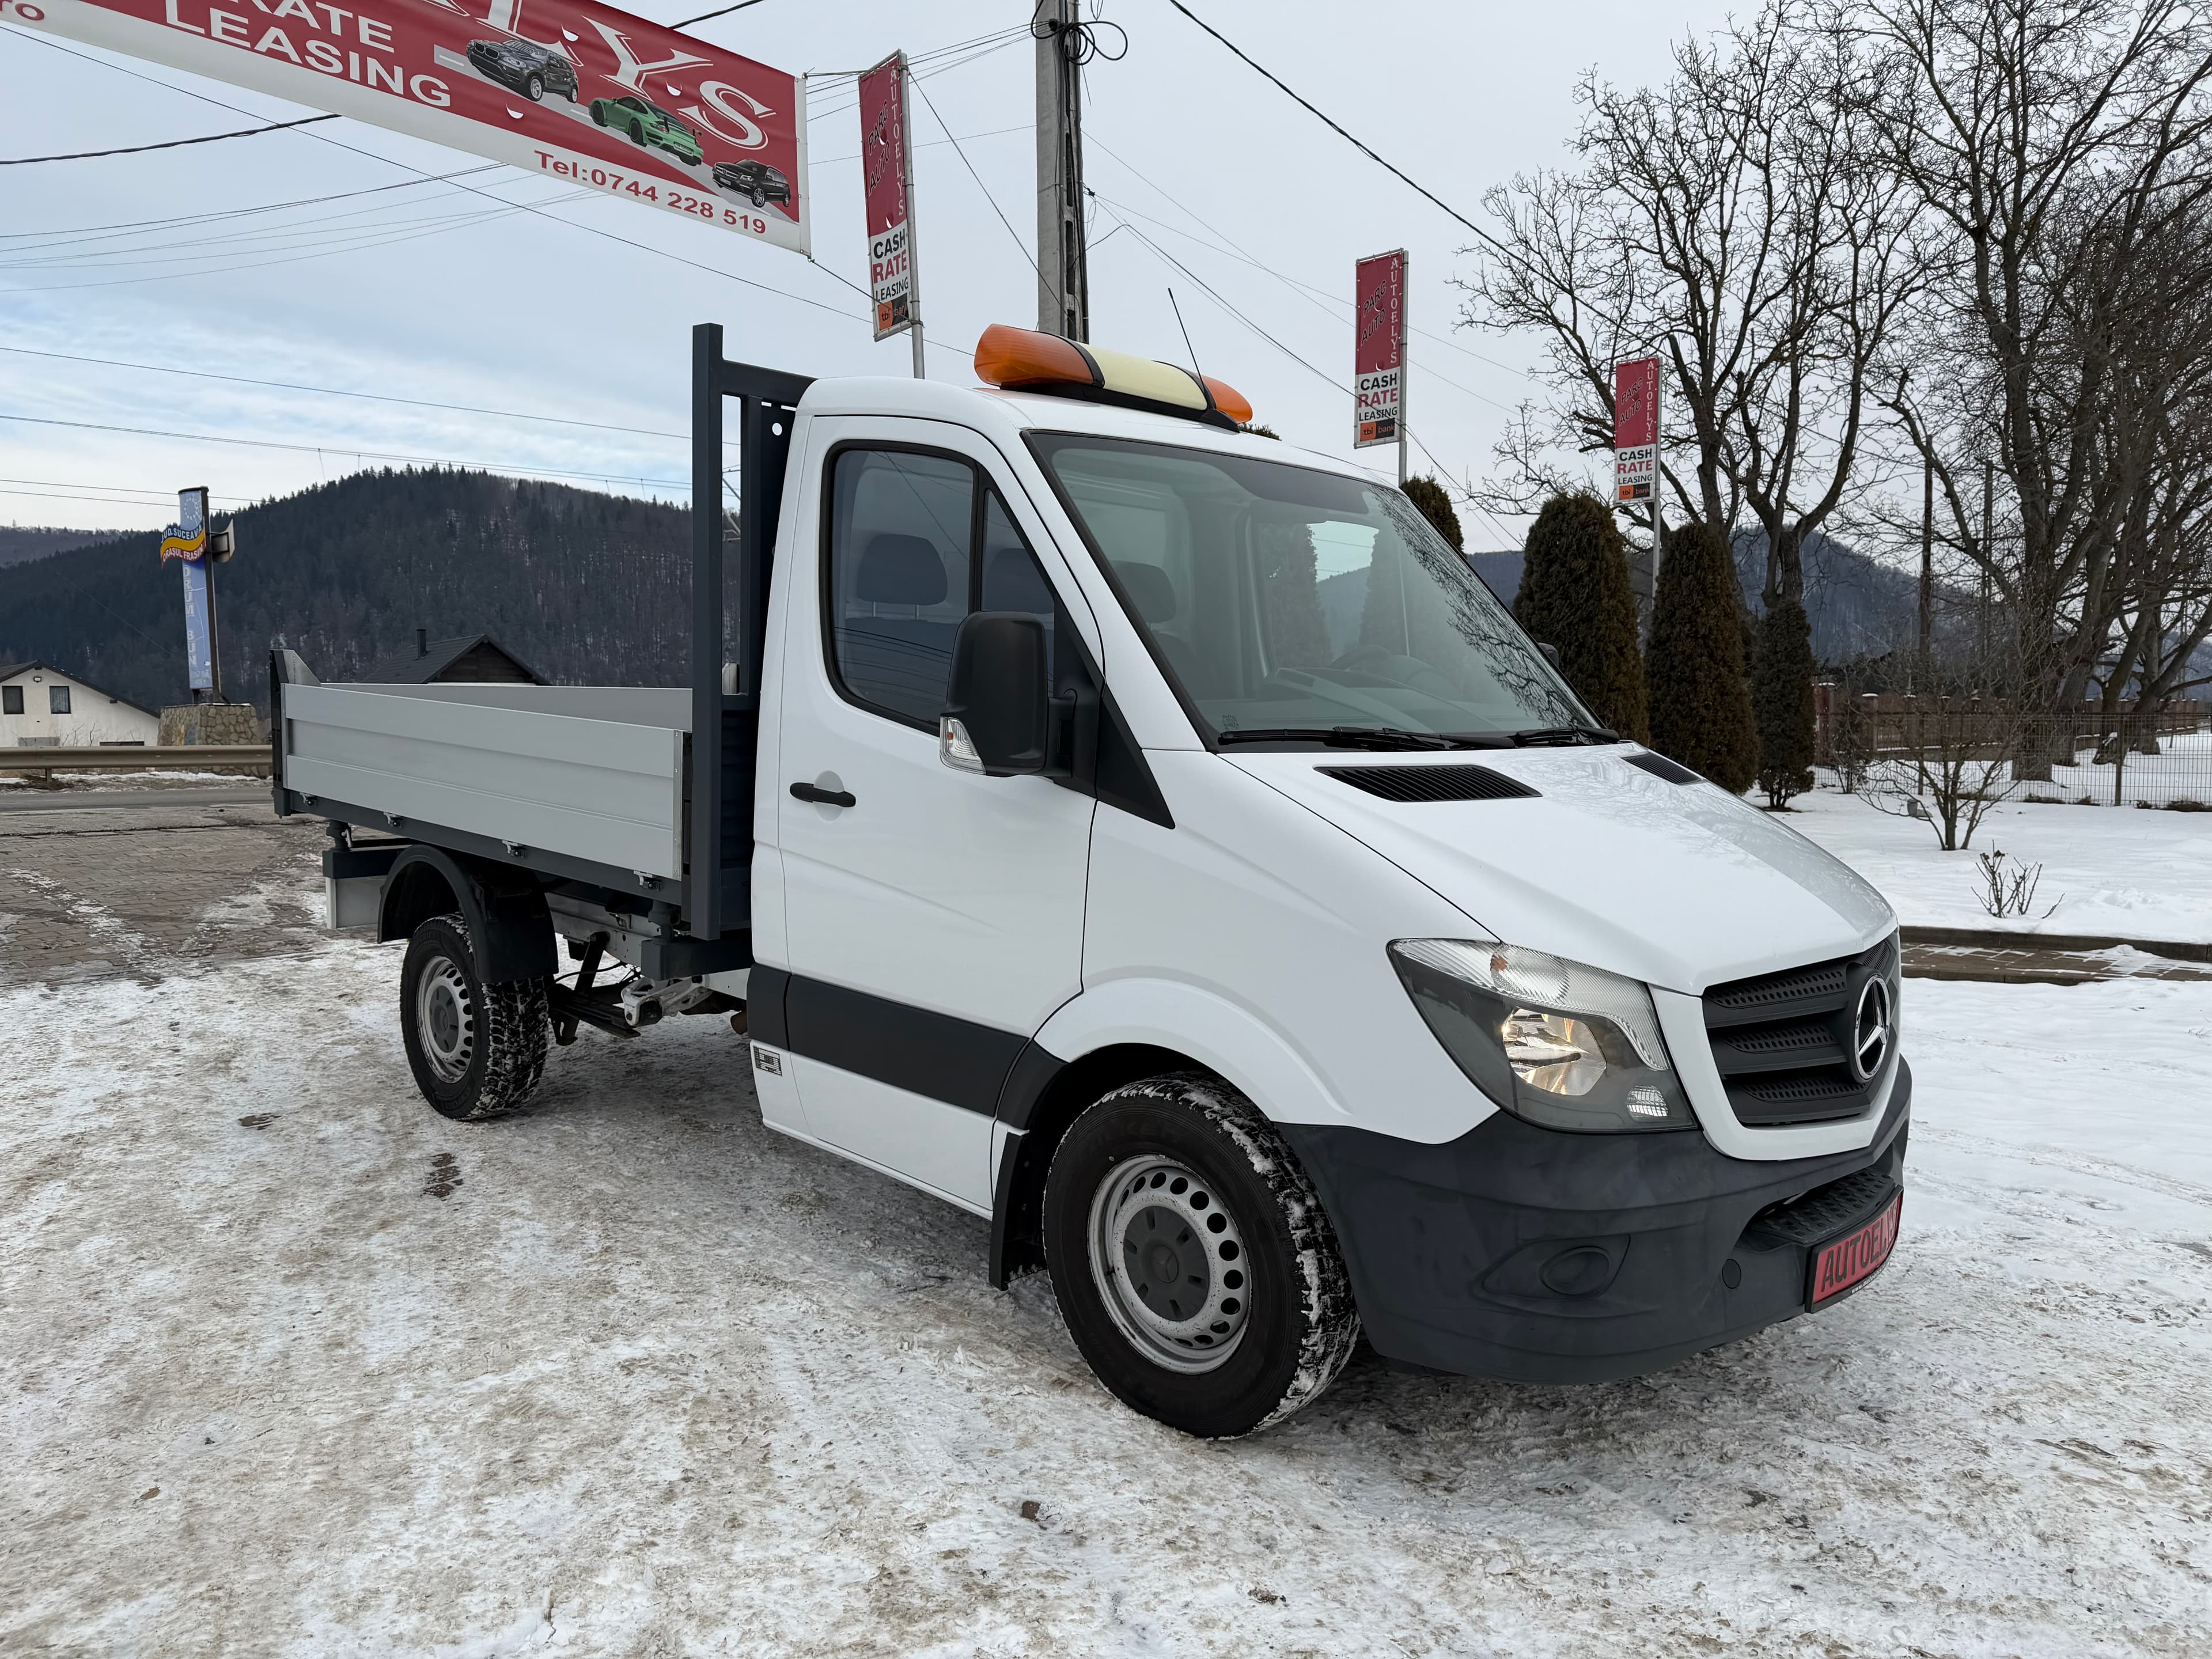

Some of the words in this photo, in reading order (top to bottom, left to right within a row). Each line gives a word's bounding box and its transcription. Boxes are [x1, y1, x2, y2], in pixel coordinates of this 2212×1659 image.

[165, 0, 451, 107] LEASING
[868, 100, 888, 156] PARC
[868, 139, 890, 196] AUTO
[533, 150, 658, 202] Tel:0744
[667, 191, 714, 218] 228
[723, 209, 767, 234] 519
[873, 228, 906, 259] CASH
[872, 249, 907, 283] RATE
[876, 276, 908, 301] LEASING
[1363, 280, 1387, 317] PARC
[881, 309, 890, 321] tbi
[1391, 257, 1399, 363] AUTOELYS
[1360, 309, 1386, 346] AUTO
[1360, 373, 1397, 391] CASH
[1621, 378, 1642, 405] PARC
[1358, 388, 1398, 408] RATE
[1646, 361, 1654, 441] AUTOELYS
[1359, 407, 1397, 422] LEASING
[1619, 399, 1642, 427] AUTO
[1363, 424, 1373, 435] tbi
[1617, 460, 1653, 474] RATE
[1619, 448, 1652, 461] CASH
[1618, 474, 1653, 484] LEASING
[174, 524, 202, 540] SUCEAVA
[183, 544, 203, 560] FRASIN
[183, 565, 194, 616] DRUM
[187, 630, 197, 666] BUN
